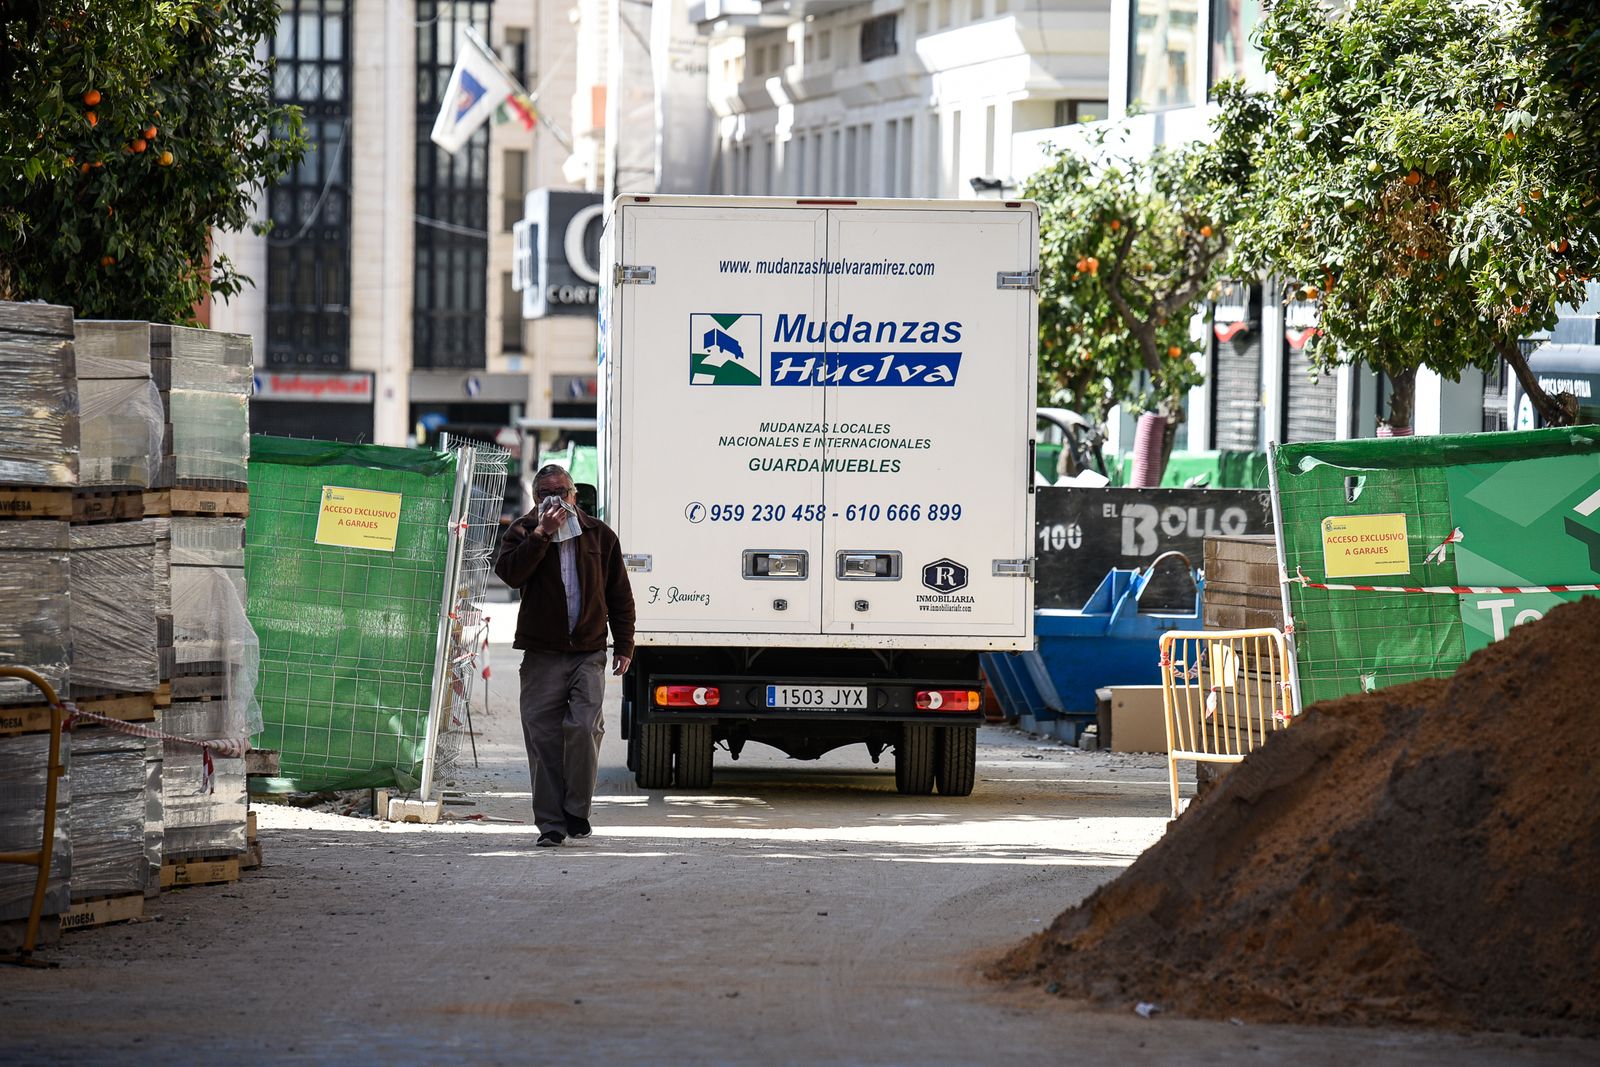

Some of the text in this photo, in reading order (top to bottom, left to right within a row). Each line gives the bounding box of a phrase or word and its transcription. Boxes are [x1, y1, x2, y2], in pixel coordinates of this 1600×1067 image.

[719, 258, 935, 276] www. mudanzashuelvaramirez.com
[773, 313, 963, 343] Mudanzas
[774, 354, 954, 383] Huelva
[759, 422, 891, 434] MUDANZAS LOCALES
[718, 436, 931, 449] NACIONALES E INTERNACIONALES
[749, 457, 901, 472] GUARDAMUEBLES
[323, 505, 397, 519] ACCESO EXCLUSIVO
[710, 504, 744, 521] 959
[751, 504, 785, 521] 230
[792, 504, 826, 521] 458
[846, 504, 880, 521] 610
[887, 504, 921, 521] 666
[927, 504, 961, 521] 899
[1102, 503, 1118, 518] EL
[345, 520, 378, 529] GARAJES
[1121, 503, 1248, 556] BOLLO
[1039, 523, 1082, 551] 100
[1326, 533, 1404, 544] ACCESO EXCLUSIVO
[1345, 546, 1389, 556] A GARAJES
[916, 595, 975, 603] INMOBILIARIA
[782, 689, 863, 705] 1503 JYX
